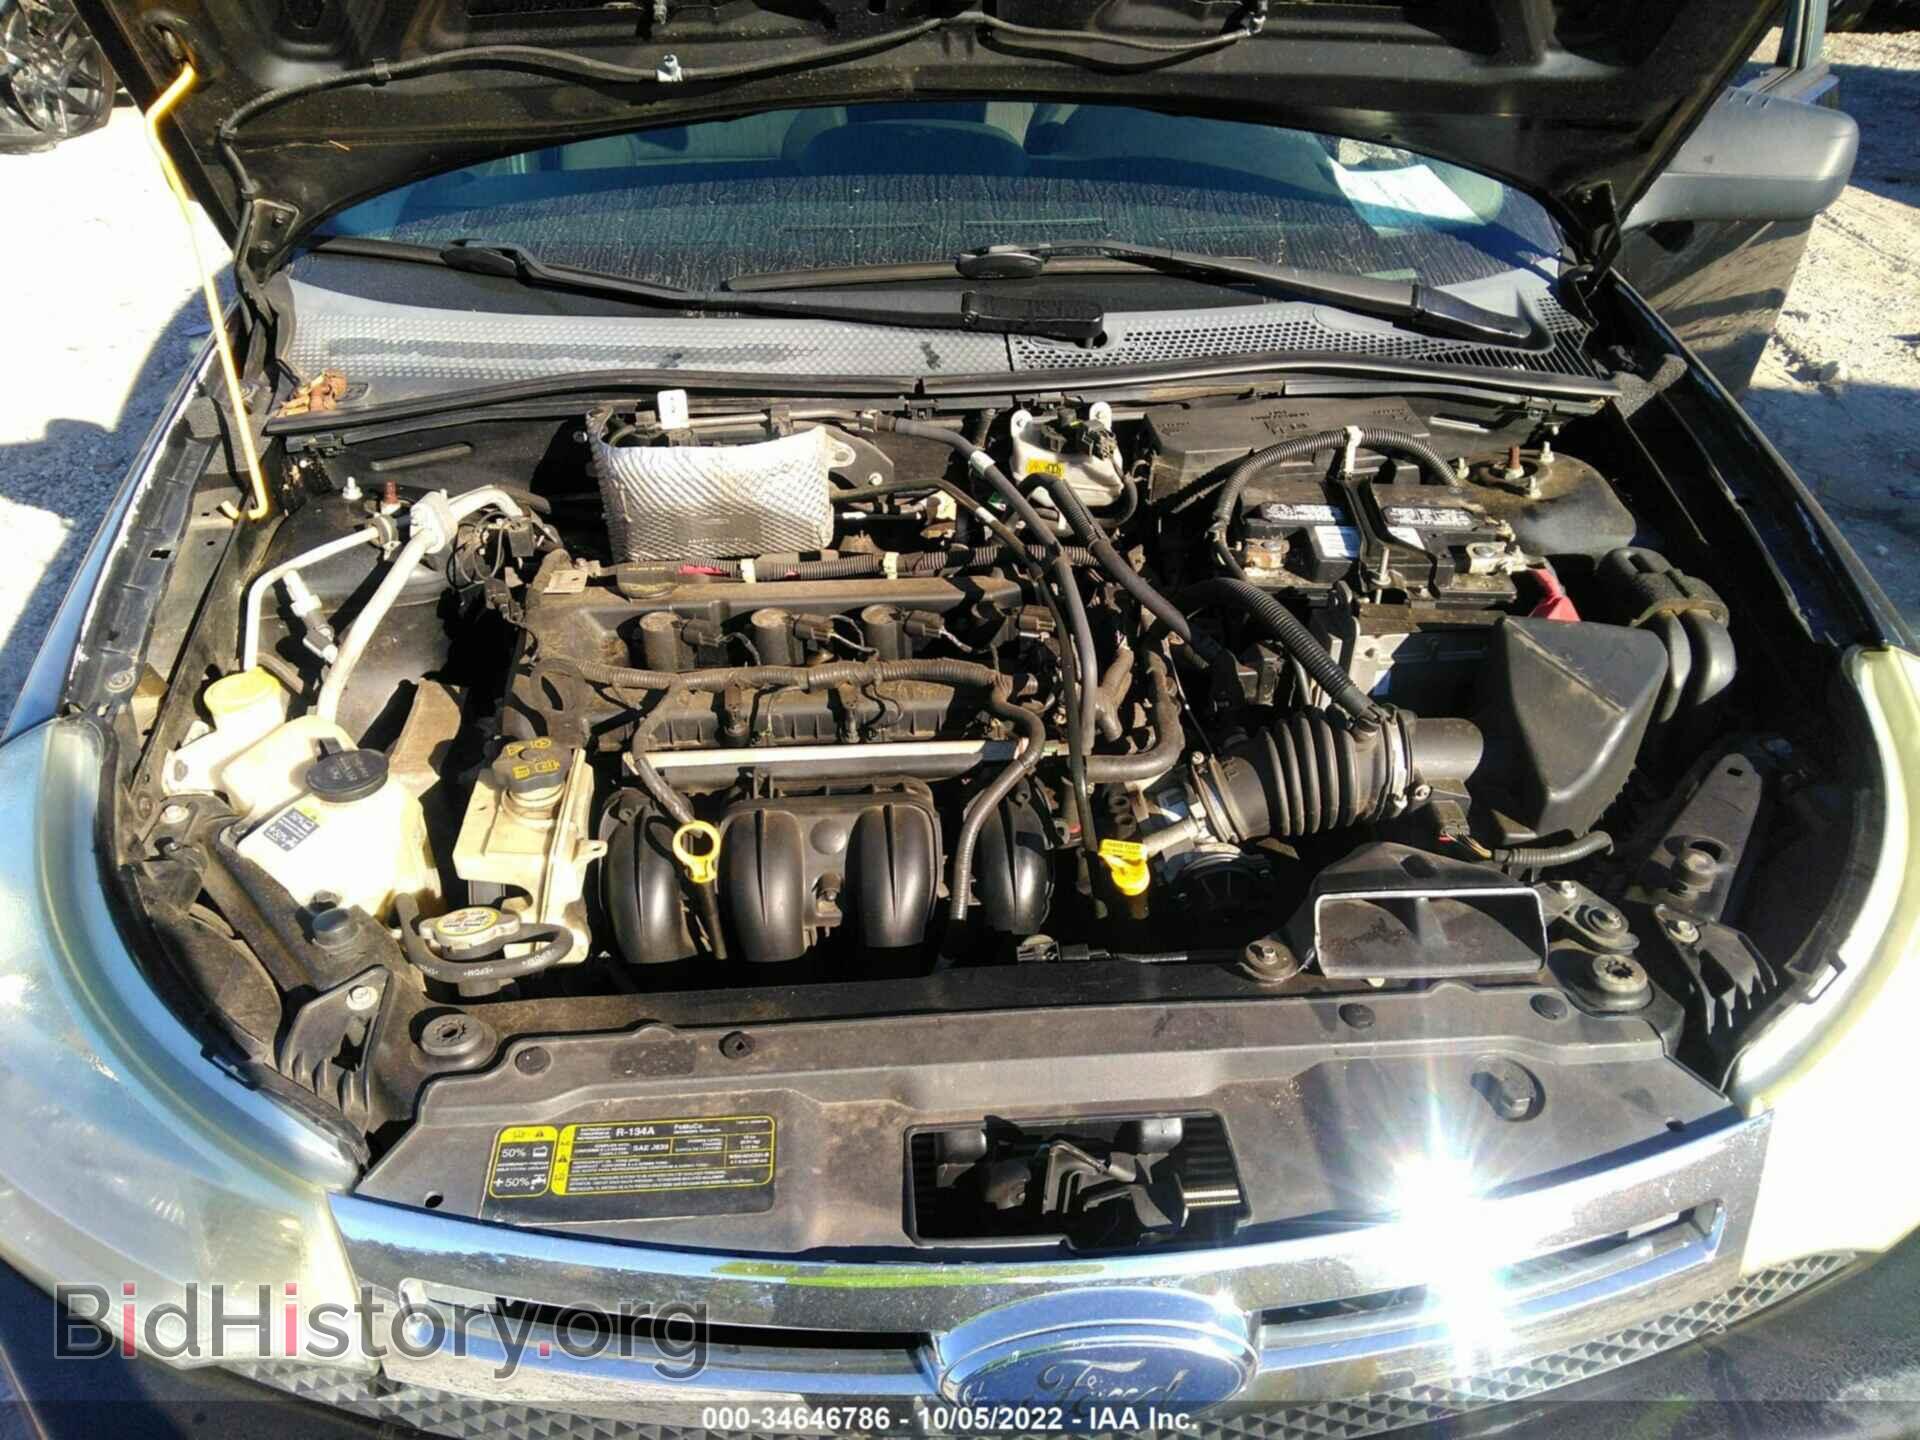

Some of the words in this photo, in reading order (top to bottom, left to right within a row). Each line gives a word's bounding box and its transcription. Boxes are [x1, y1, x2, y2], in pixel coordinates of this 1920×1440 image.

[616, 1126, 655, 1137] R-134A
[502, 1148, 526, 1158] 50%
[505, 1177, 529, 1187] 50%
